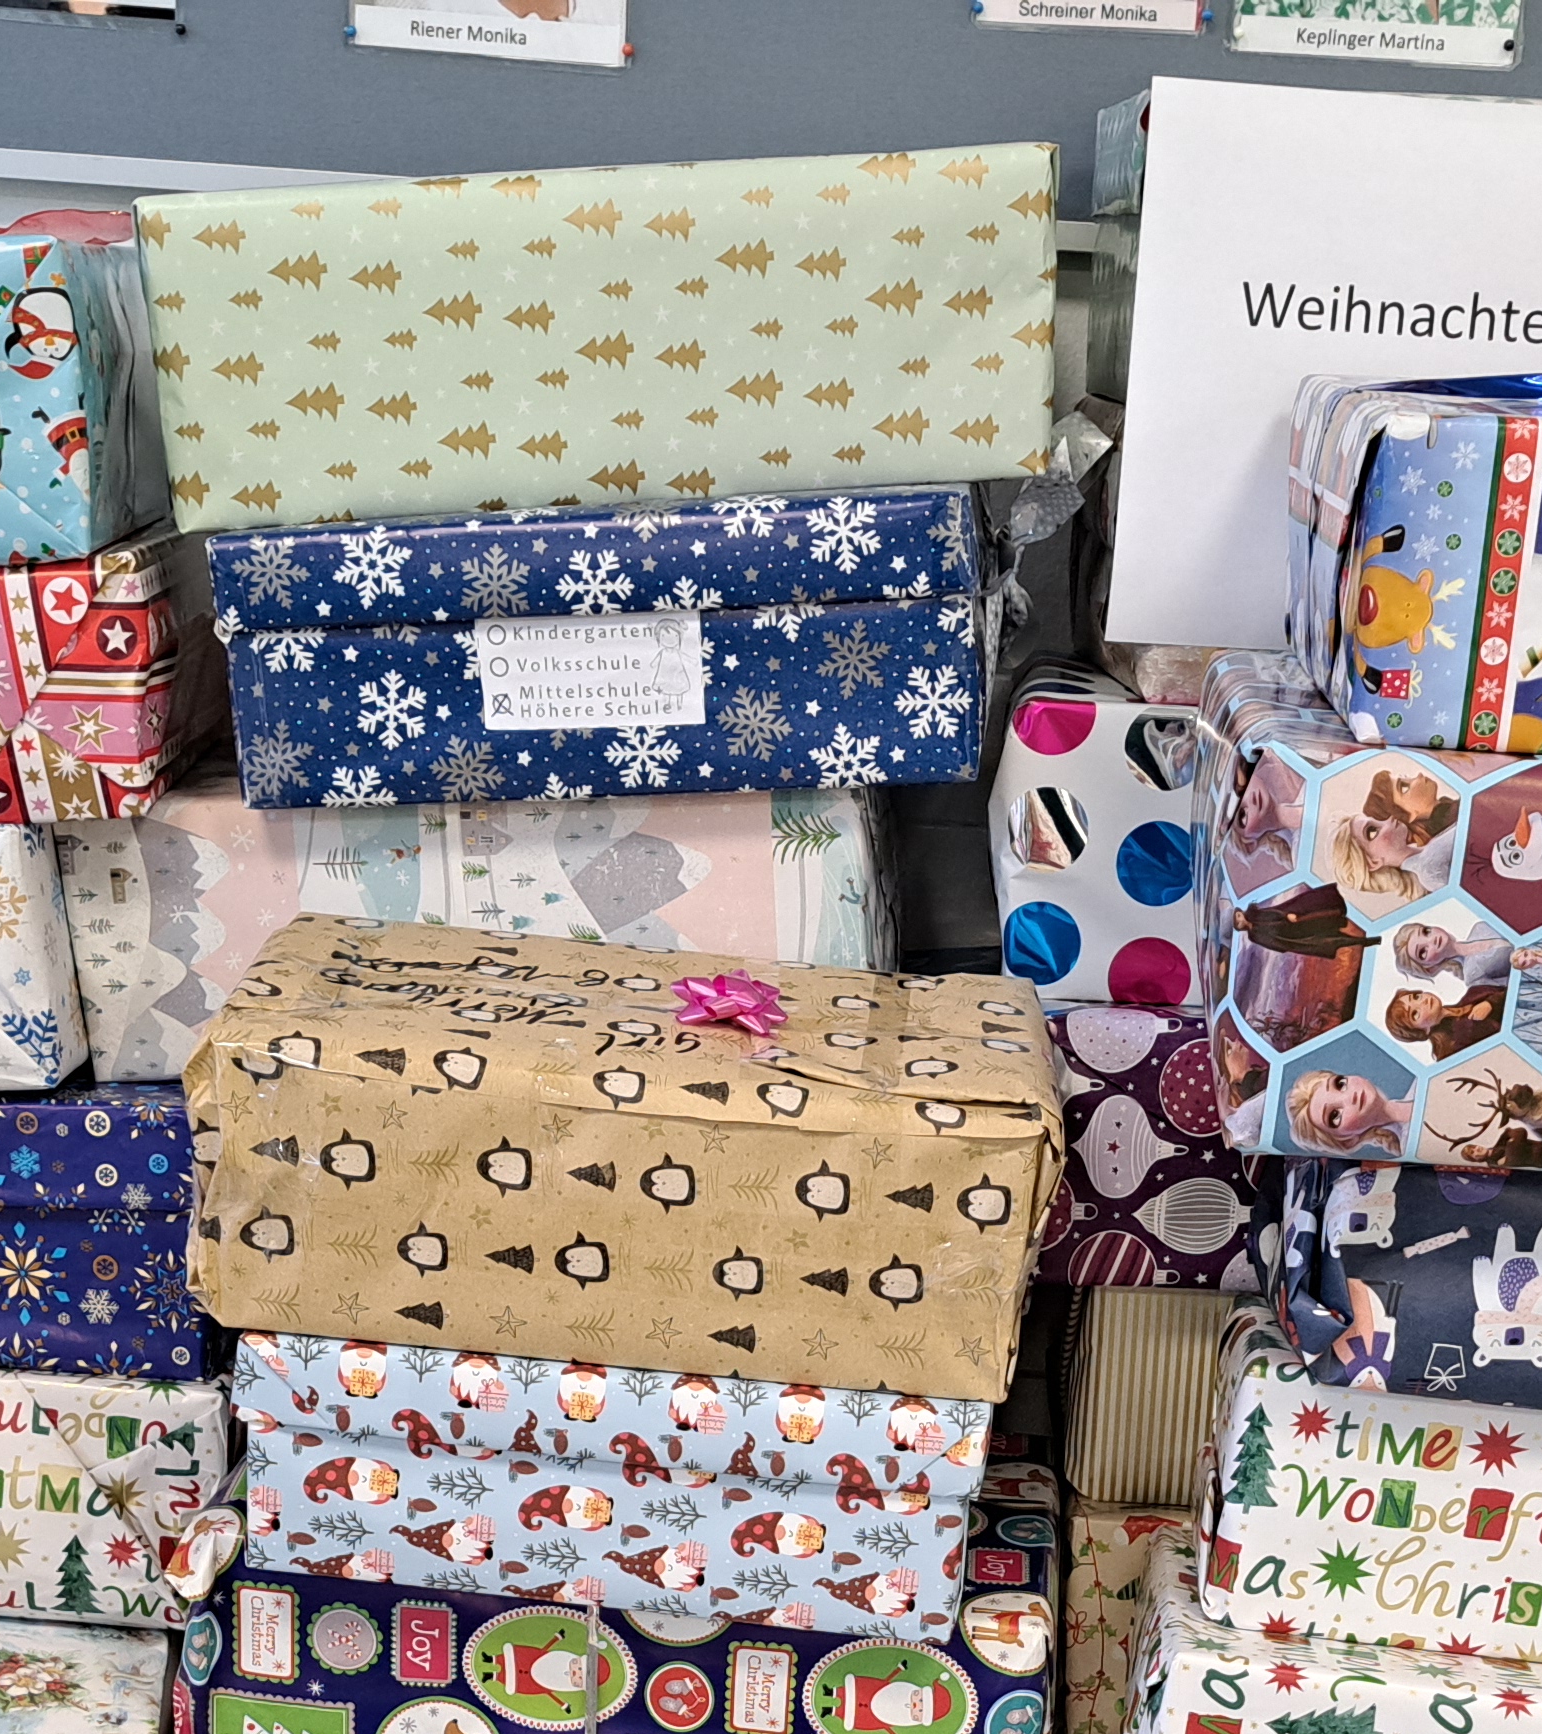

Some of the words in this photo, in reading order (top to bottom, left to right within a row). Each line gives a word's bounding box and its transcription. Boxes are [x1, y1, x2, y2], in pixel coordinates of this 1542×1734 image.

[1018, 0, 1095, 20] Schreiner
[1100, 4, 1158, 22] Monika
[410, 20, 462, 39] Riener
[467, 26, 527, 45] Monika
[1295, 27, 1374, 49] Keplinger
[1380, 32, 1446, 52] Martina
[512, 624, 653, 643] Kindergarten
[516, 654, 642, 673] Volksschule
[519, 682, 652, 700] Mittelschule
[520, 701, 595, 718] Höhere
[604, 700, 672, 717] Schule
[981, 1556, 1013, 1579] Joy
[249, 1596, 263, 1668] Christmas
[265, 1612, 280, 1657] Merry
[407, 1619, 440, 1672] Joy
[744, 1654, 761, 1724] Christmas
[762, 1671, 778, 1715] Merry
